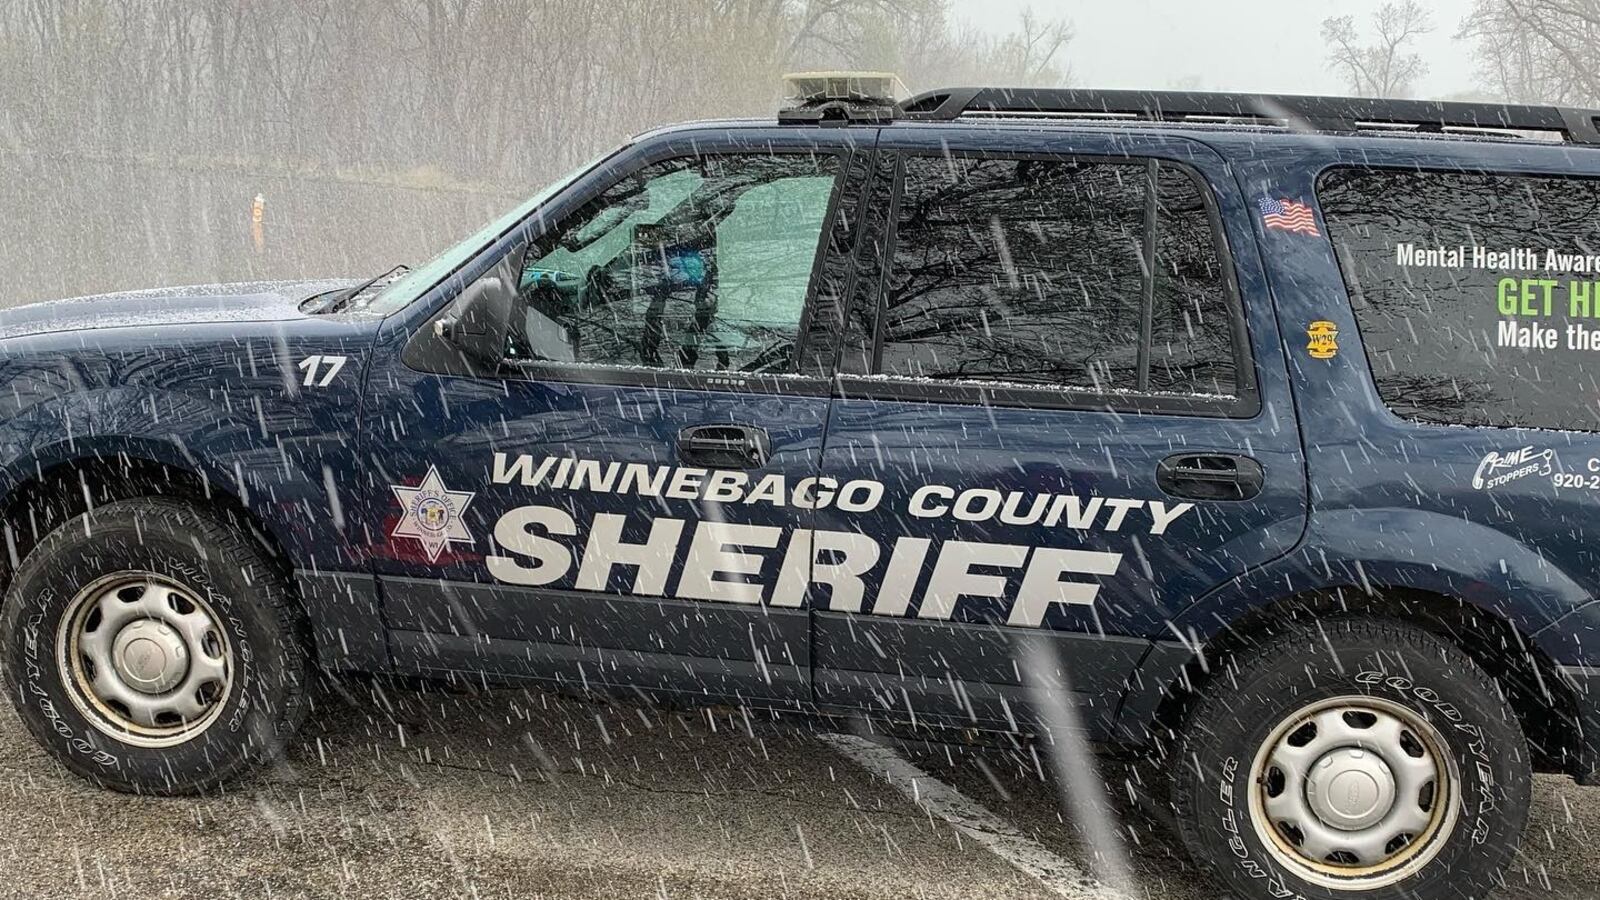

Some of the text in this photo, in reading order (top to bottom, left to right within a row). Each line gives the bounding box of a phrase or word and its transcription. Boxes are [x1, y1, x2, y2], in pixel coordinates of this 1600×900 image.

[1396, 243, 1465, 269] Mental
[1472, 246, 1538, 271] Health
[1498, 278, 1558, 316] GET
[1498, 321, 1600, 350] Make the
[298, 355, 347, 387] 17
[1472, 445, 1534, 489] CRIME
[1486, 463, 1539, 489] STOPPERS
[1553, 472, 1600, 489] 920-2
[441, 495, 457, 518] OFFICE
[492, 452, 1195, 536] WINNEBAGO COUNTY
[485, 505, 1123, 628] SHERIFF
[168, 557, 254, 733] WRANGLER
[23, 588, 118, 766] GOODYEAR
[1355, 671, 1495, 845] GOODYEAR
